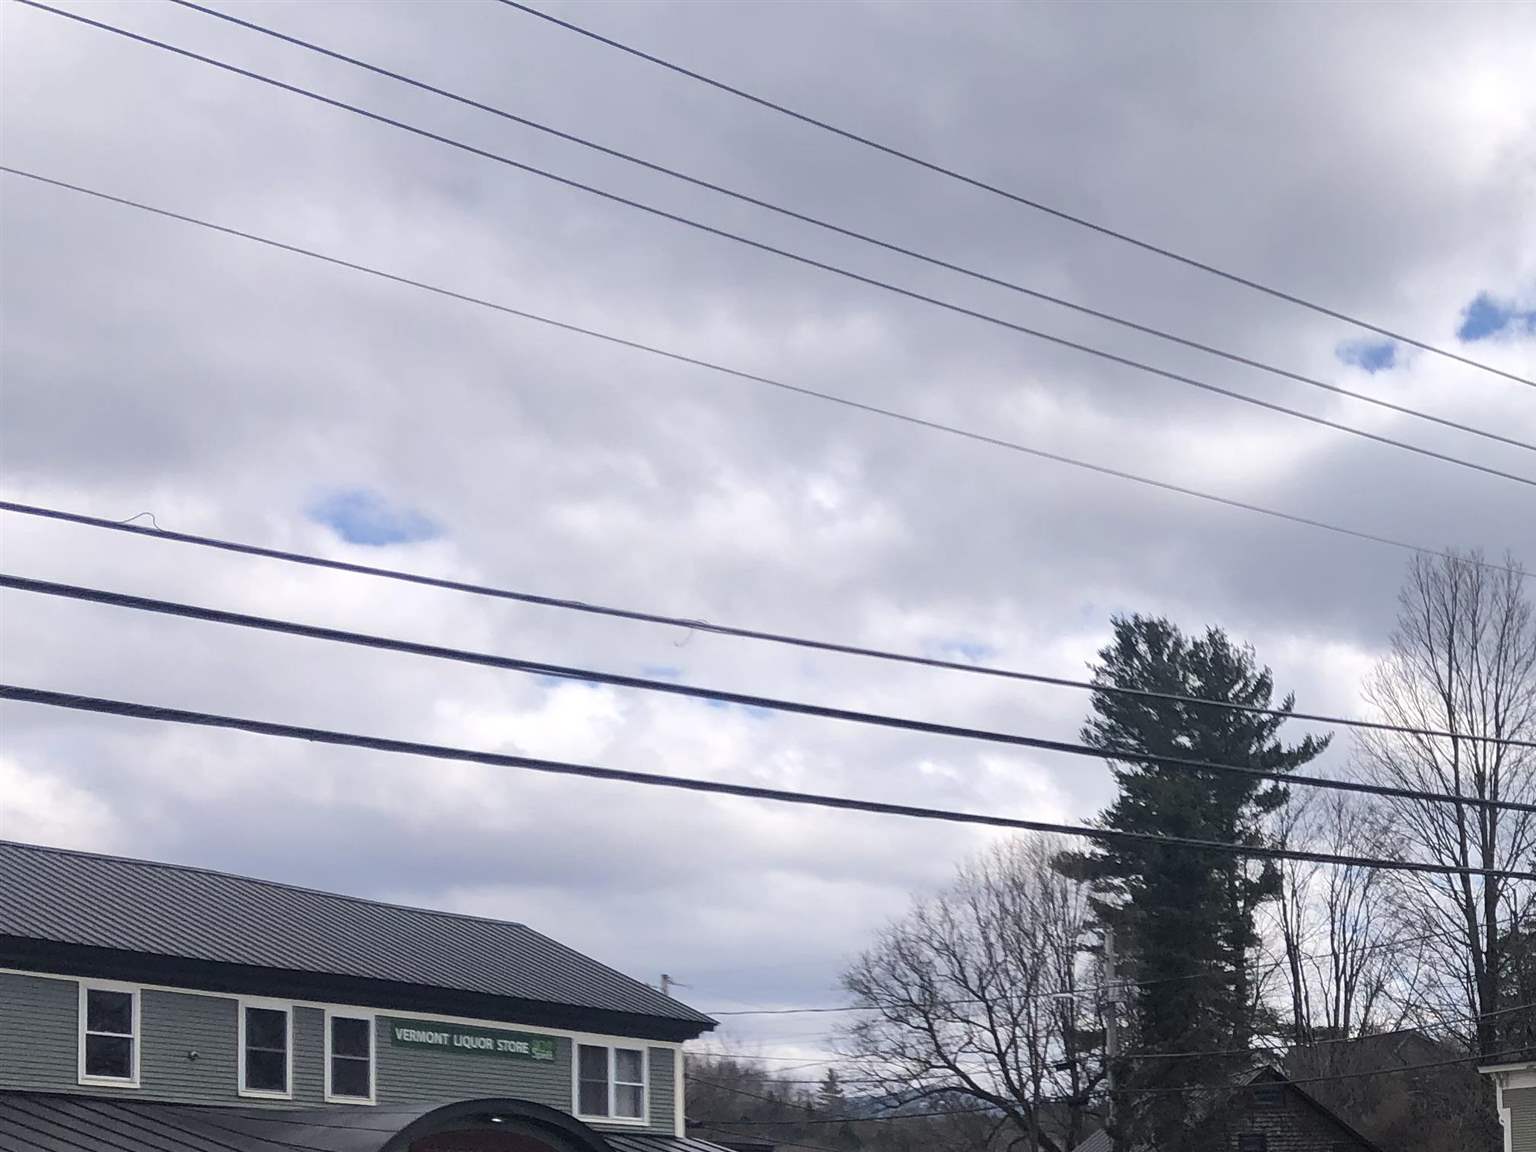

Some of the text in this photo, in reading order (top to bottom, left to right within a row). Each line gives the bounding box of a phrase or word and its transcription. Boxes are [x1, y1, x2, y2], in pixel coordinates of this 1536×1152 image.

[394, 1027, 450, 1045] VERMONT
[453, 1033, 494, 1050] LIQUOR
[497, 1038, 529, 1054] STORE
